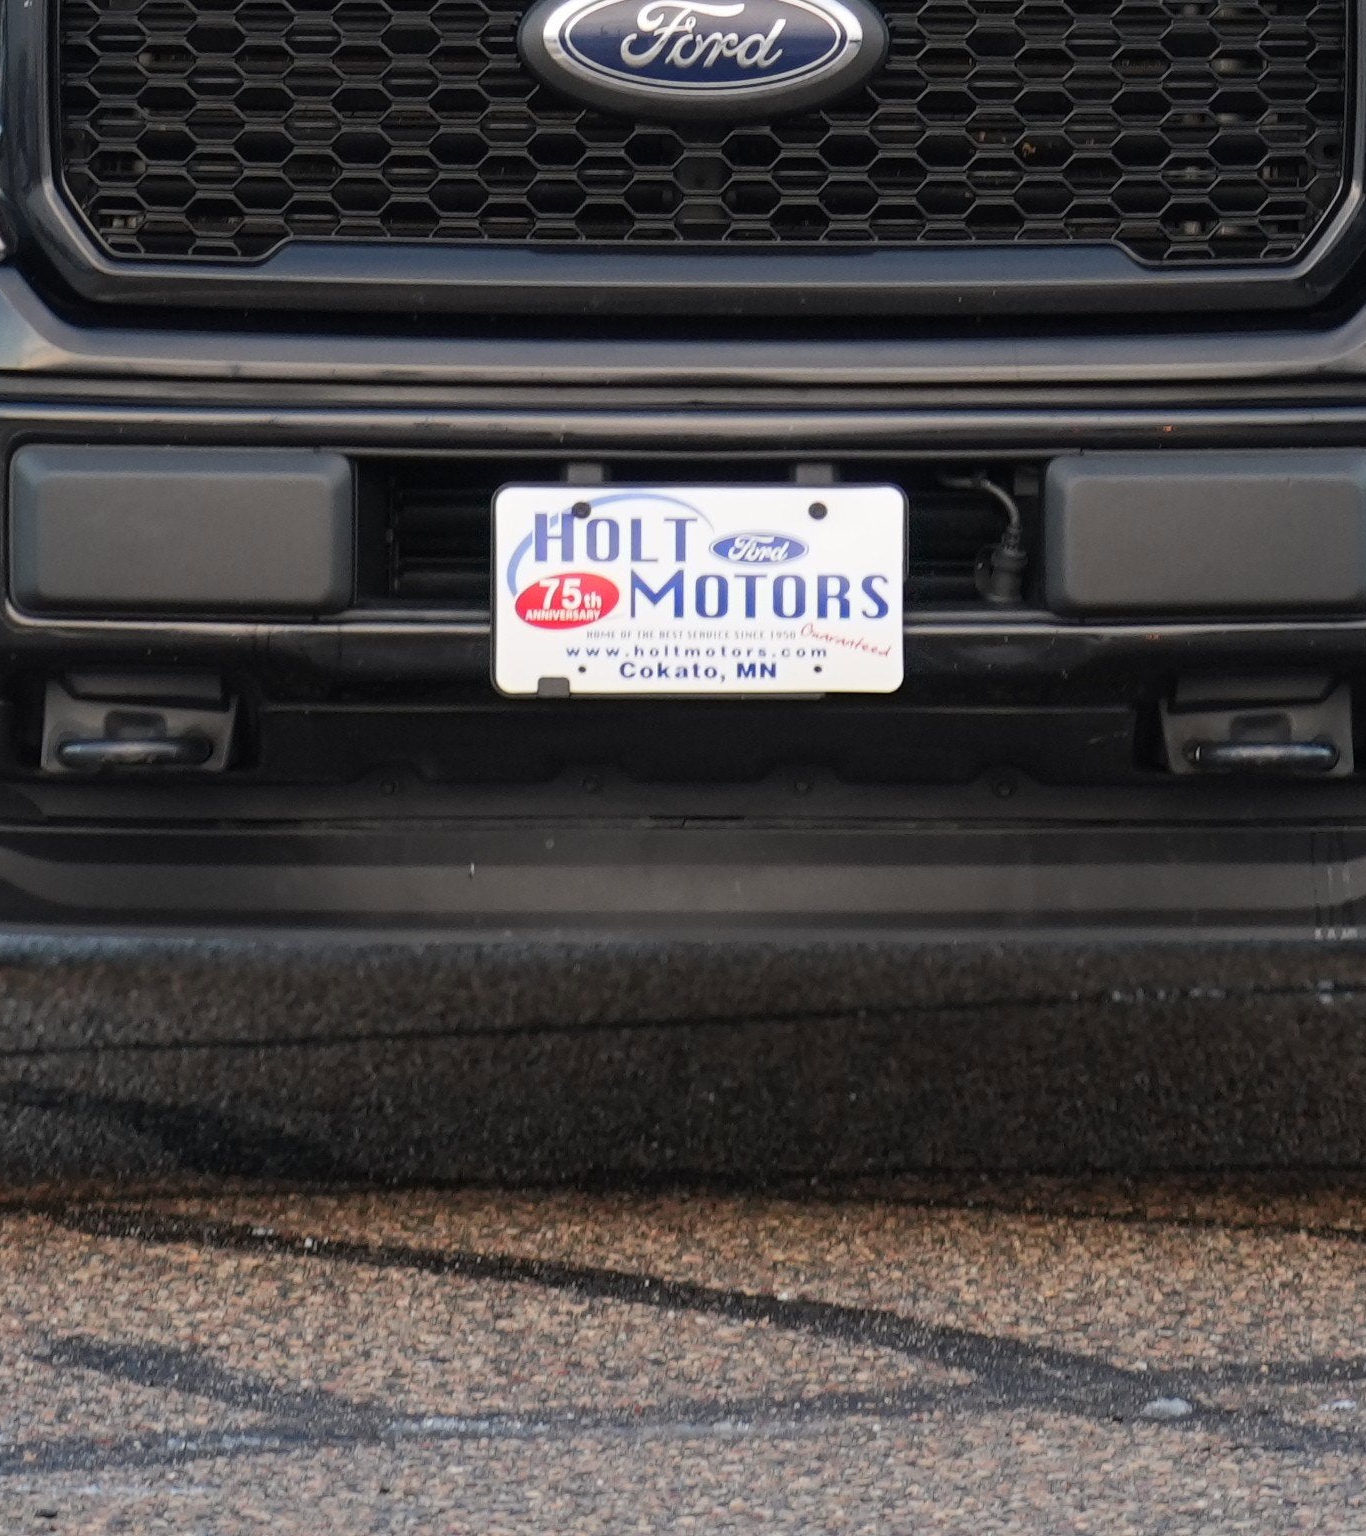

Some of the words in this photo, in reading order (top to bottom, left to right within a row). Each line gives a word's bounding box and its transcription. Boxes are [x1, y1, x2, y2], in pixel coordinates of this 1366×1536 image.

[620, 0, 787, 68] Ford
[534, 512, 698, 562] HOLT
[727, 534, 789, 562] Ford
[538, 577, 602, 610] 75th
[630, 568, 889, 619] MOTORS
[524, 609, 601, 621] ANNIVERSARY
[566, 645, 827, 658] www.holtmotors.com
[619, 662, 725, 682] Cokato,
[737, 662, 776, 678] MN
